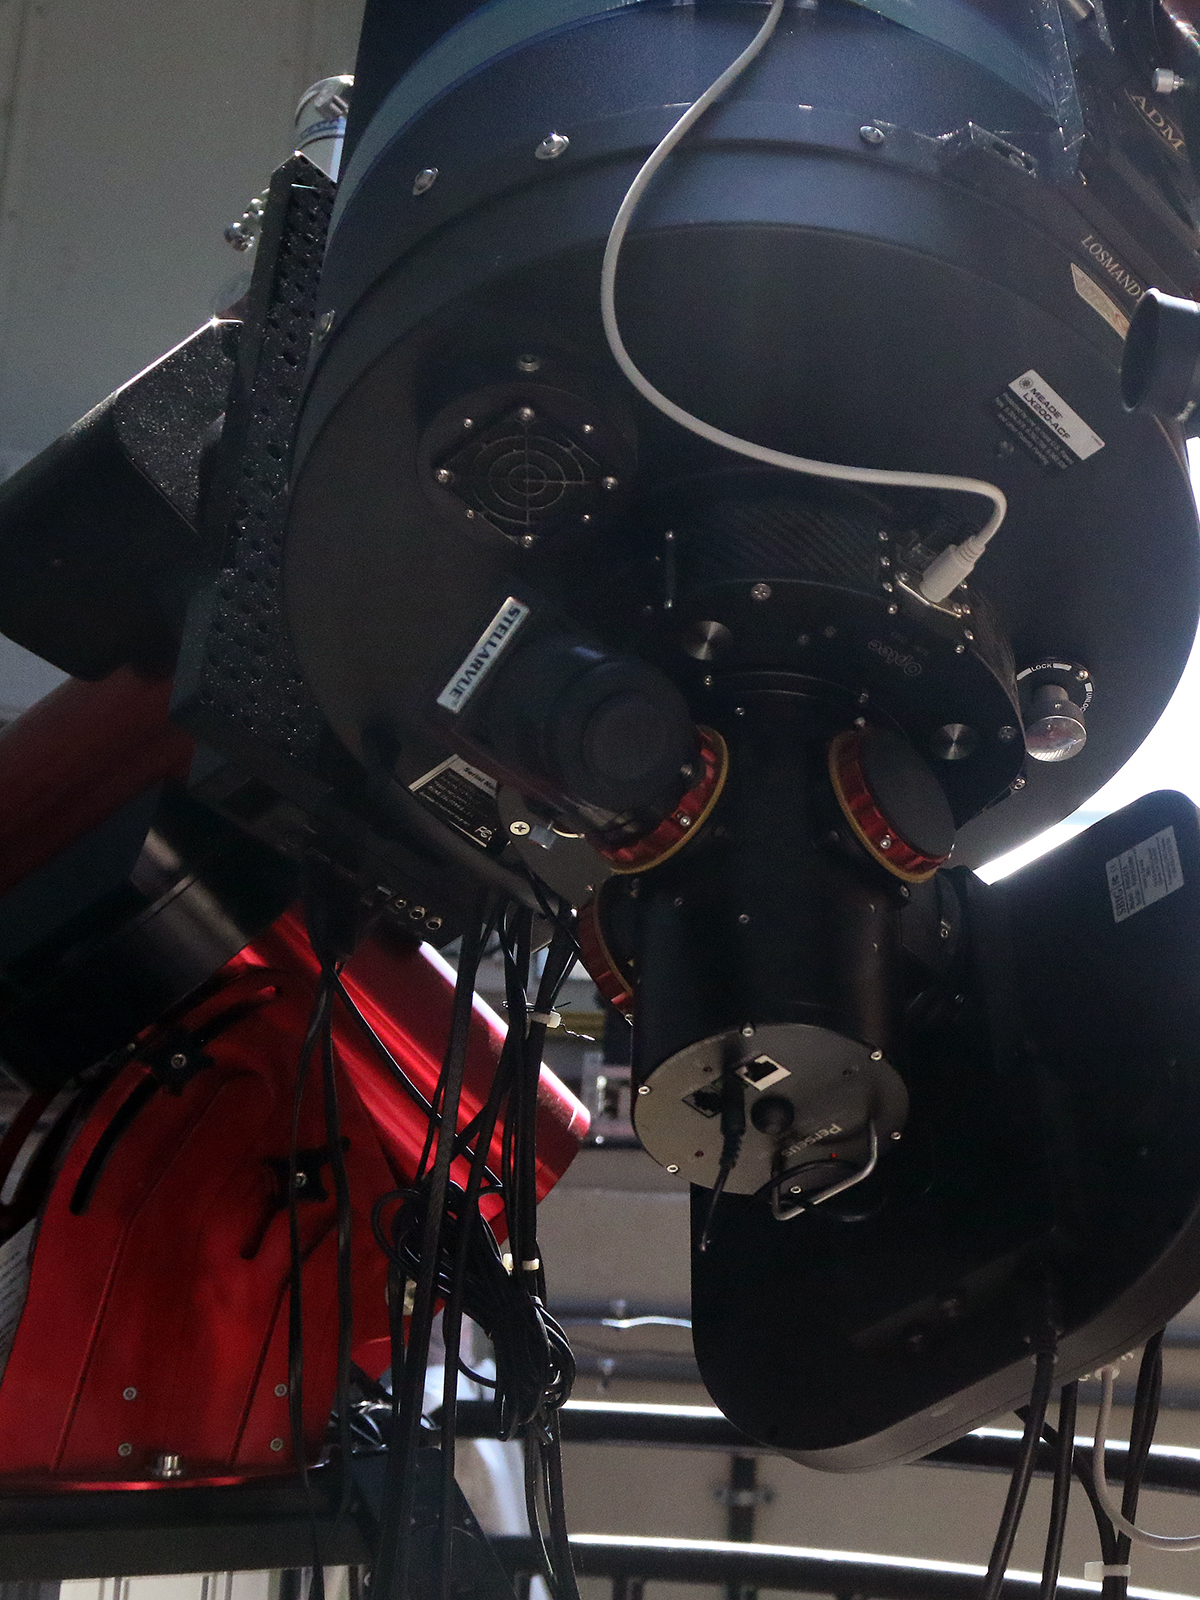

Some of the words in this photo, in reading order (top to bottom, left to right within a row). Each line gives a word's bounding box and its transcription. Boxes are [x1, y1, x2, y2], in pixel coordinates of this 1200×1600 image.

[1130, 94, 1185, 150] ADM
[1023, 393, 1071, 439] LX200-ACF
[1030, 387, 1061, 419] MEADE
[449, 605, 520, 699] STELLARVUE
[1031, 663, 1053, 672] LOCK
[1080, 692, 1092, 712] UNLOC
[781, 1123, 842, 1157] Perseus
